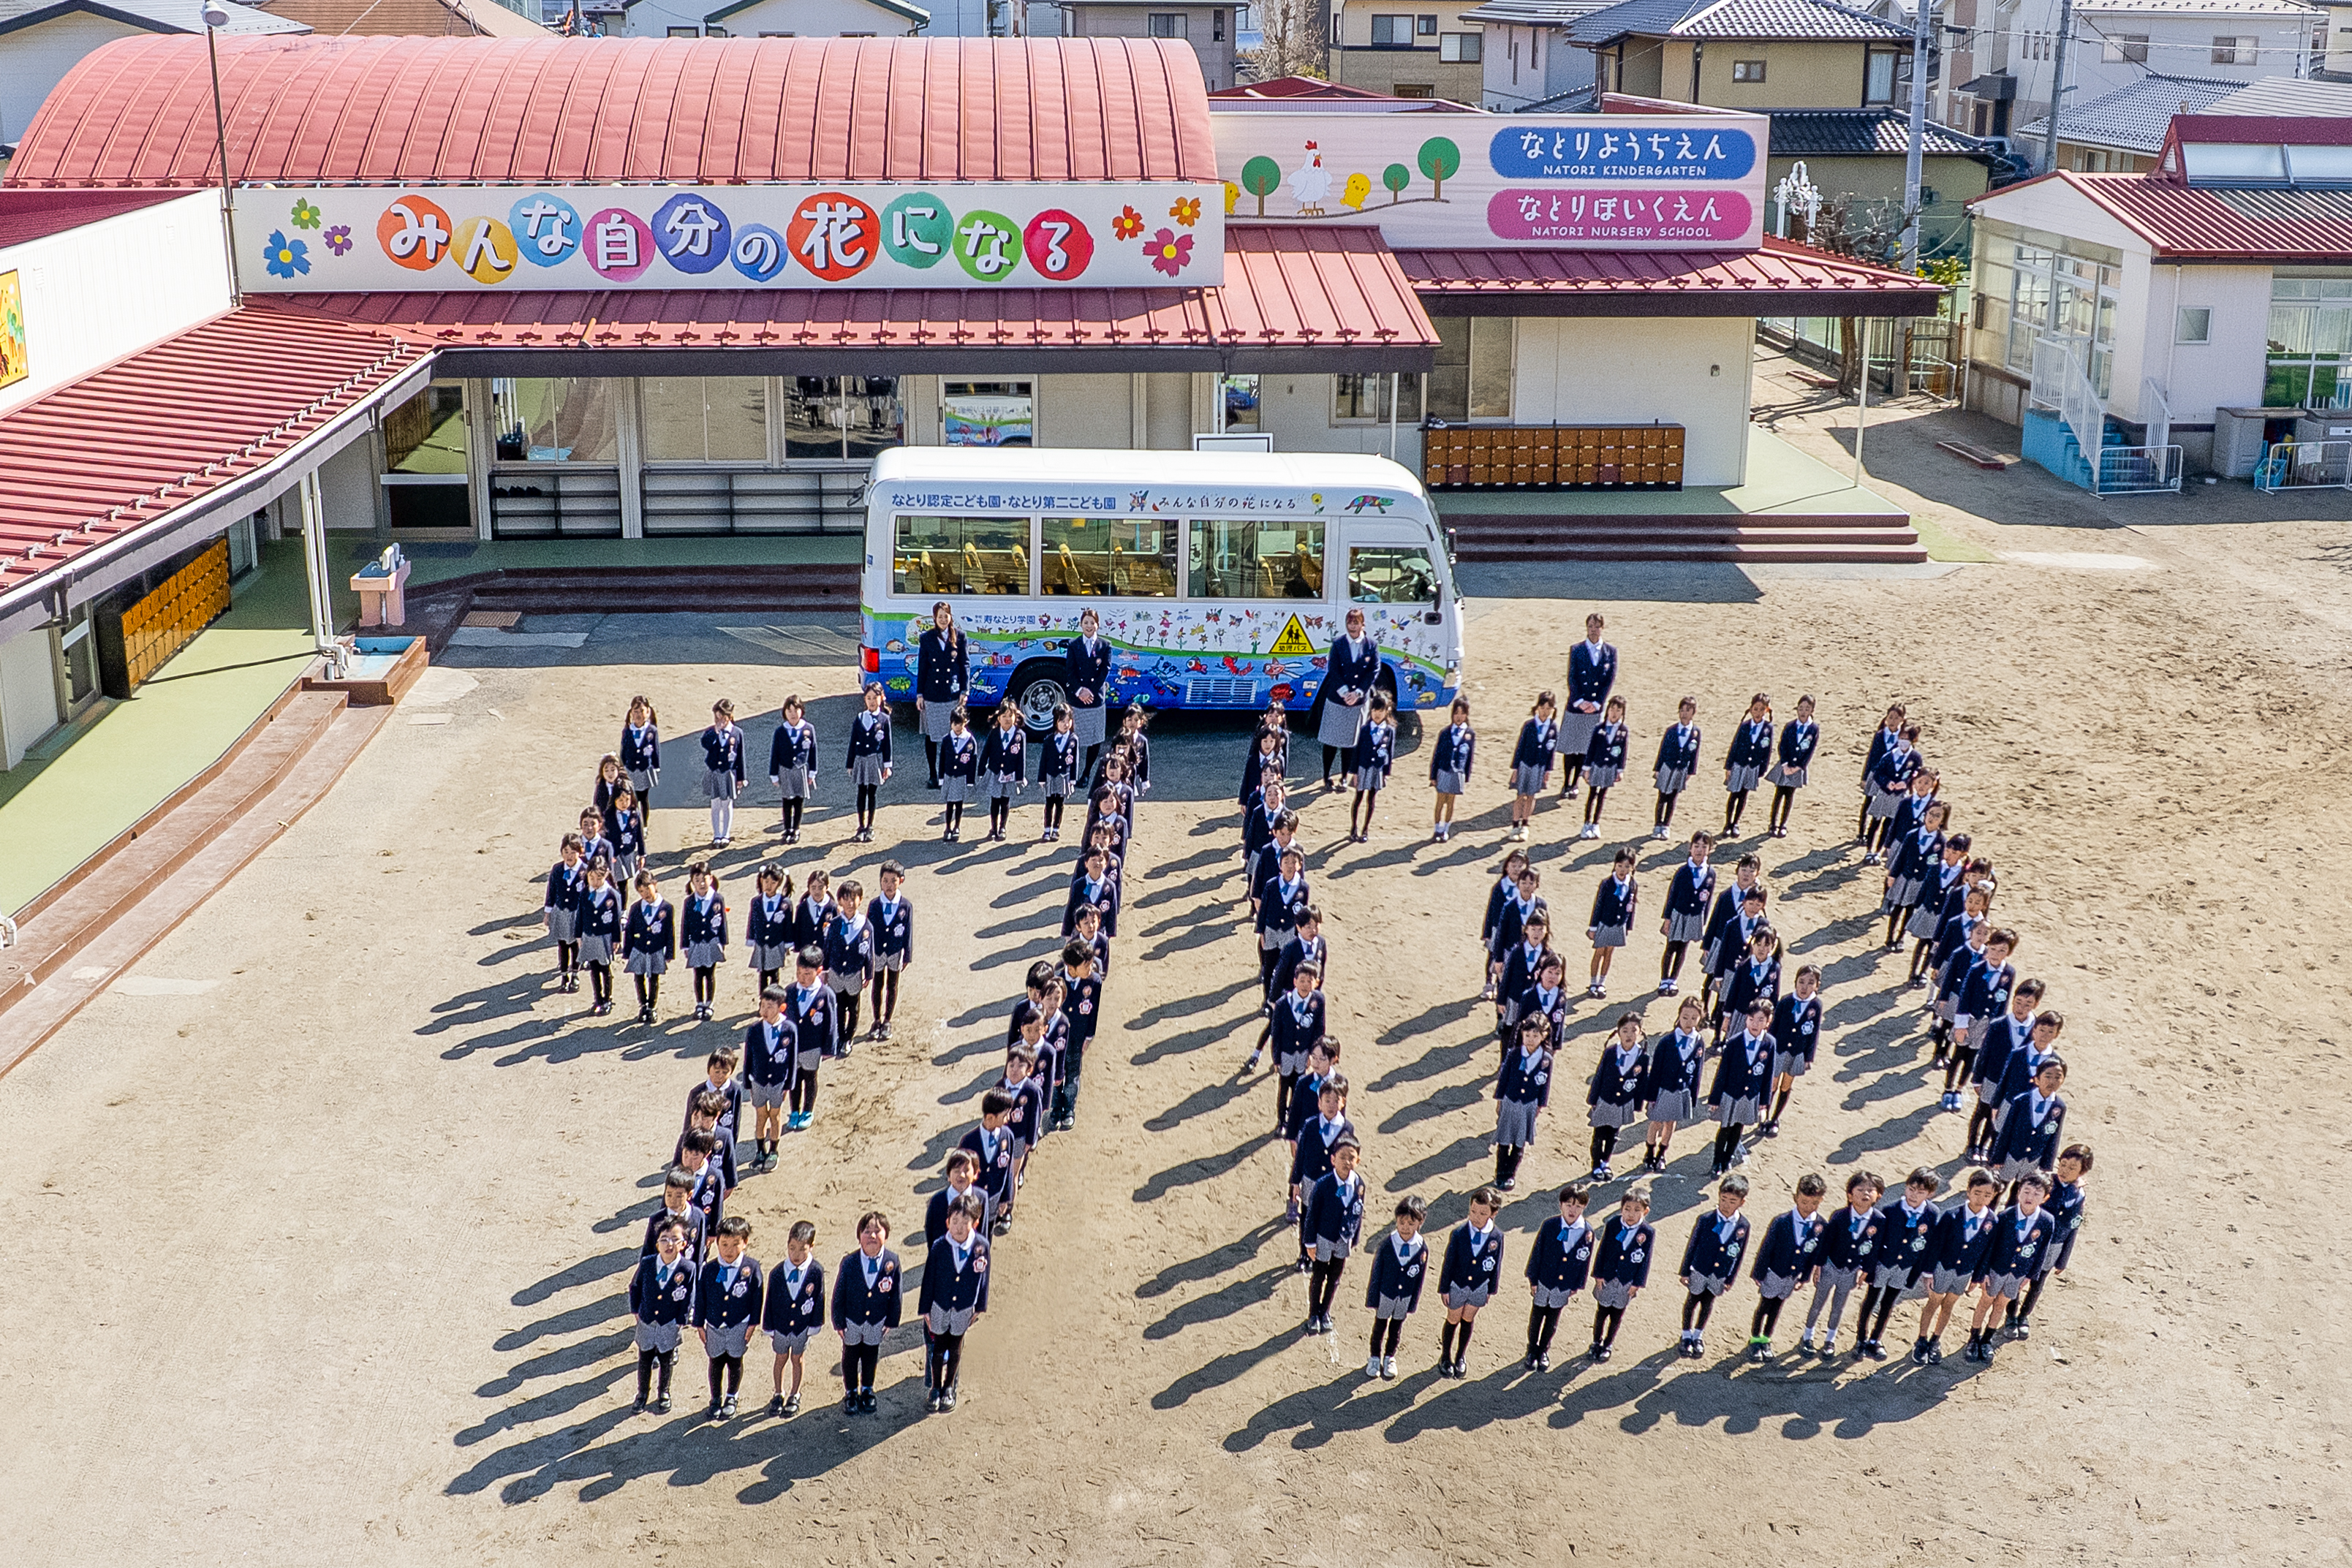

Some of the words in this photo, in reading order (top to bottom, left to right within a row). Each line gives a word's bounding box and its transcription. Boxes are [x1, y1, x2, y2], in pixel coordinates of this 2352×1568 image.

[1520, 132, 1727, 161] なとりようちえん
[1543, 164, 1595, 175] NATORI
[1603, 165, 1706, 176] KINDERGARTEN
[1518, 195, 1721, 221] なとりほいくえん
[390, 200, 1070, 273] みんな自分の花になる
[1532, 227, 1584, 236] NATORI
[1592, 227, 1652, 237] NURSERY
[1659, 227, 1712, 237] SCHOOL
[1159, 495, 1296, 510] みんな自分の花になる
